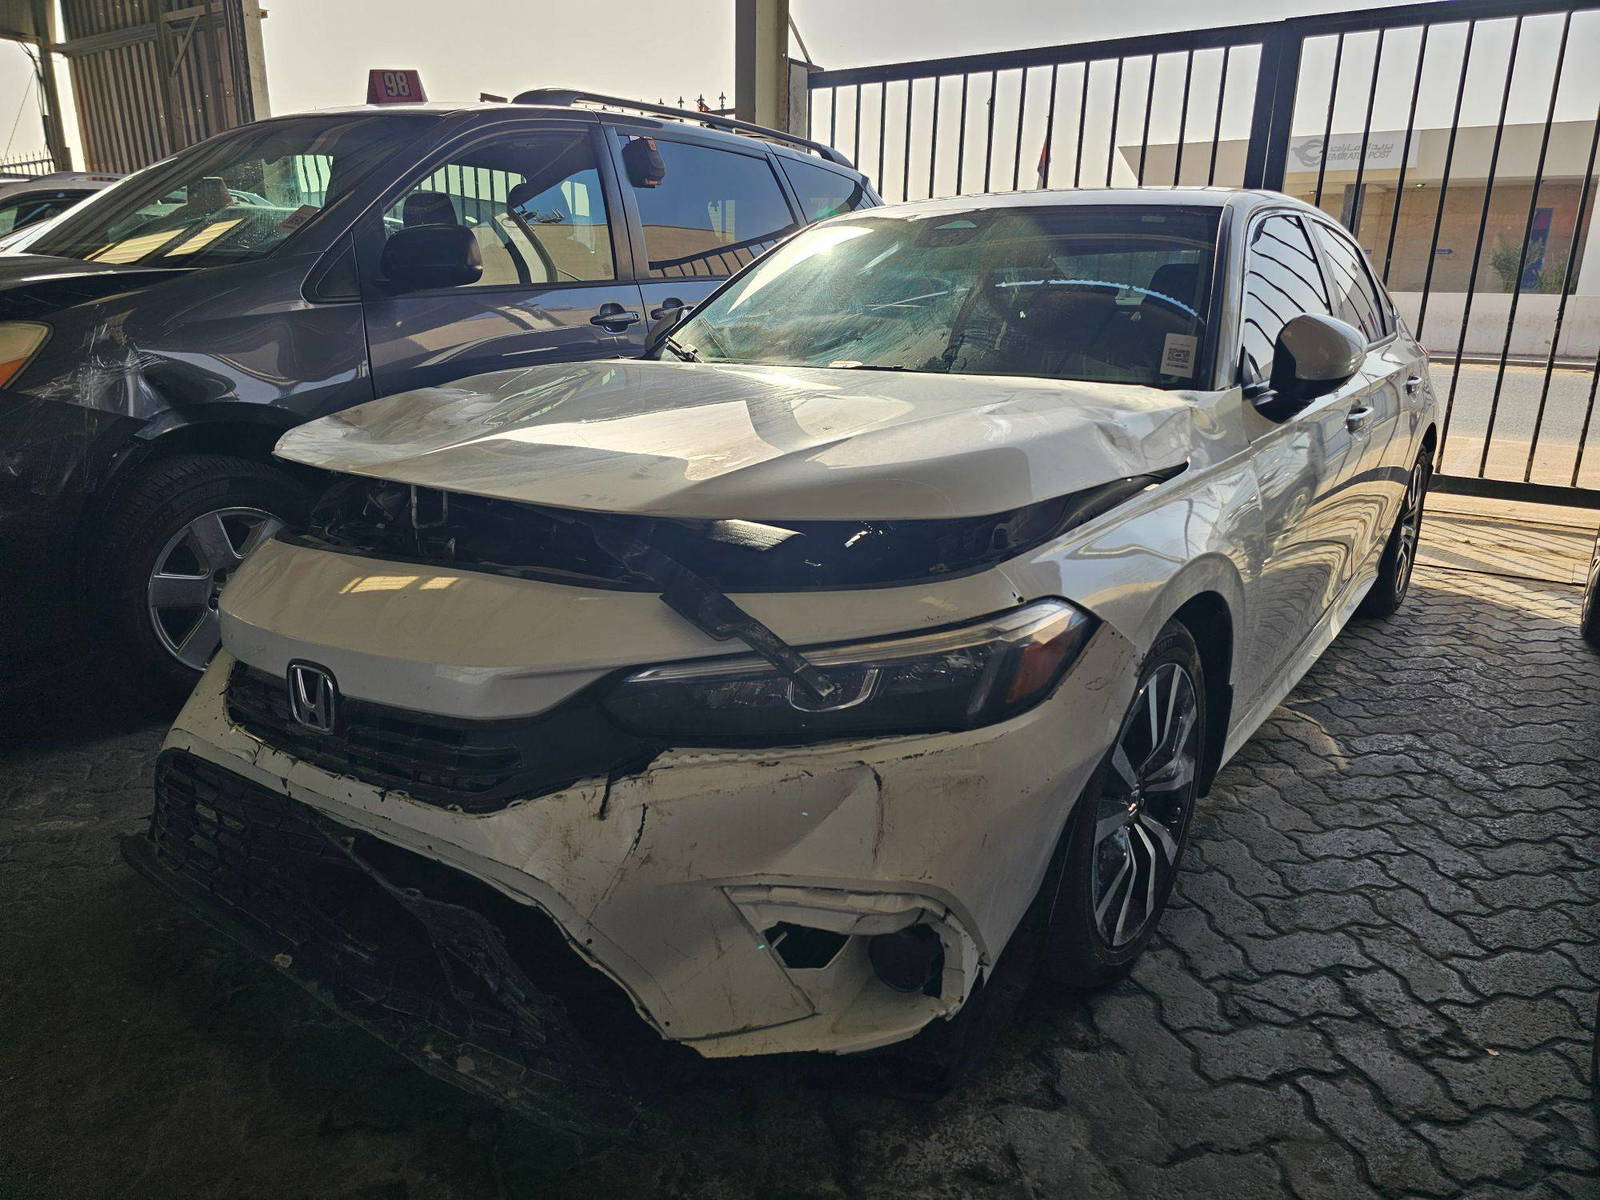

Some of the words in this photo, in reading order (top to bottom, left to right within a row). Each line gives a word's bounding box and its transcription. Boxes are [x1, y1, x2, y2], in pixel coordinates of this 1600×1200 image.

[384, 71, 411, 97] 98
[1327, 151, 1364, 160] EMIRAT
[1368, 150, 1392, 159] POST
